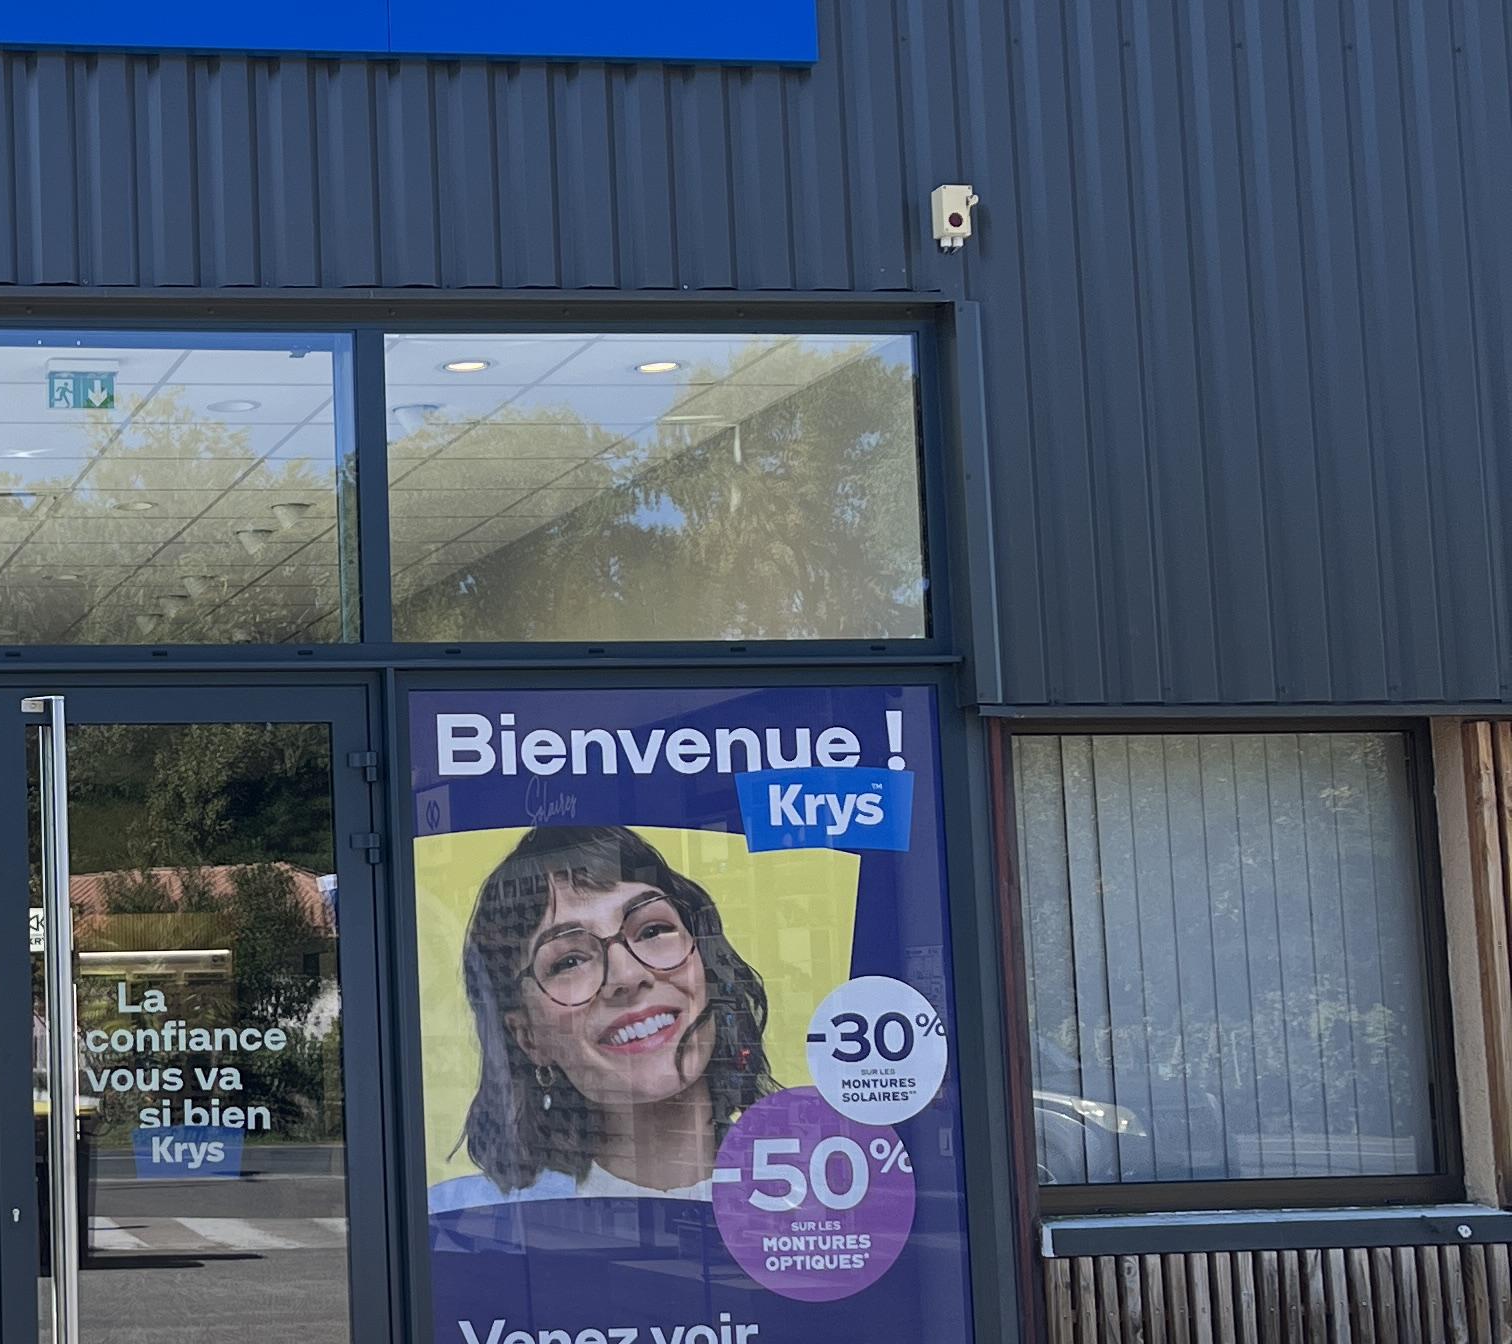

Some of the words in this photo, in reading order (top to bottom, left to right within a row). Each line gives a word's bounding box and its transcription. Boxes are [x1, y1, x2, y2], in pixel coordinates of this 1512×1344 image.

[436, 713, 861, 775] Bienvenue
[885, 710, 906, 771] !
[117, 981, 168, 1013] La
[85, 1020, 288, 1053] confiance
[806, 1011, 947, 1063] -30%
[86, 1066, 184, 1092] vous
[193, 1065, 244, 1091] va
[841, 1077, 917, 1089] MONTURES
[138, 1099, 171, 1130] si
[183, 1098, 272, 1130] bien
[151, 1135, 225, 1169] Krys
[712, 1135, 914, 1212] -50%
[791, 1221, 816, 1231] SUR
[818, 1220, 841, 1231] LES
[762, 1234, 872, 1252] MONTURES
